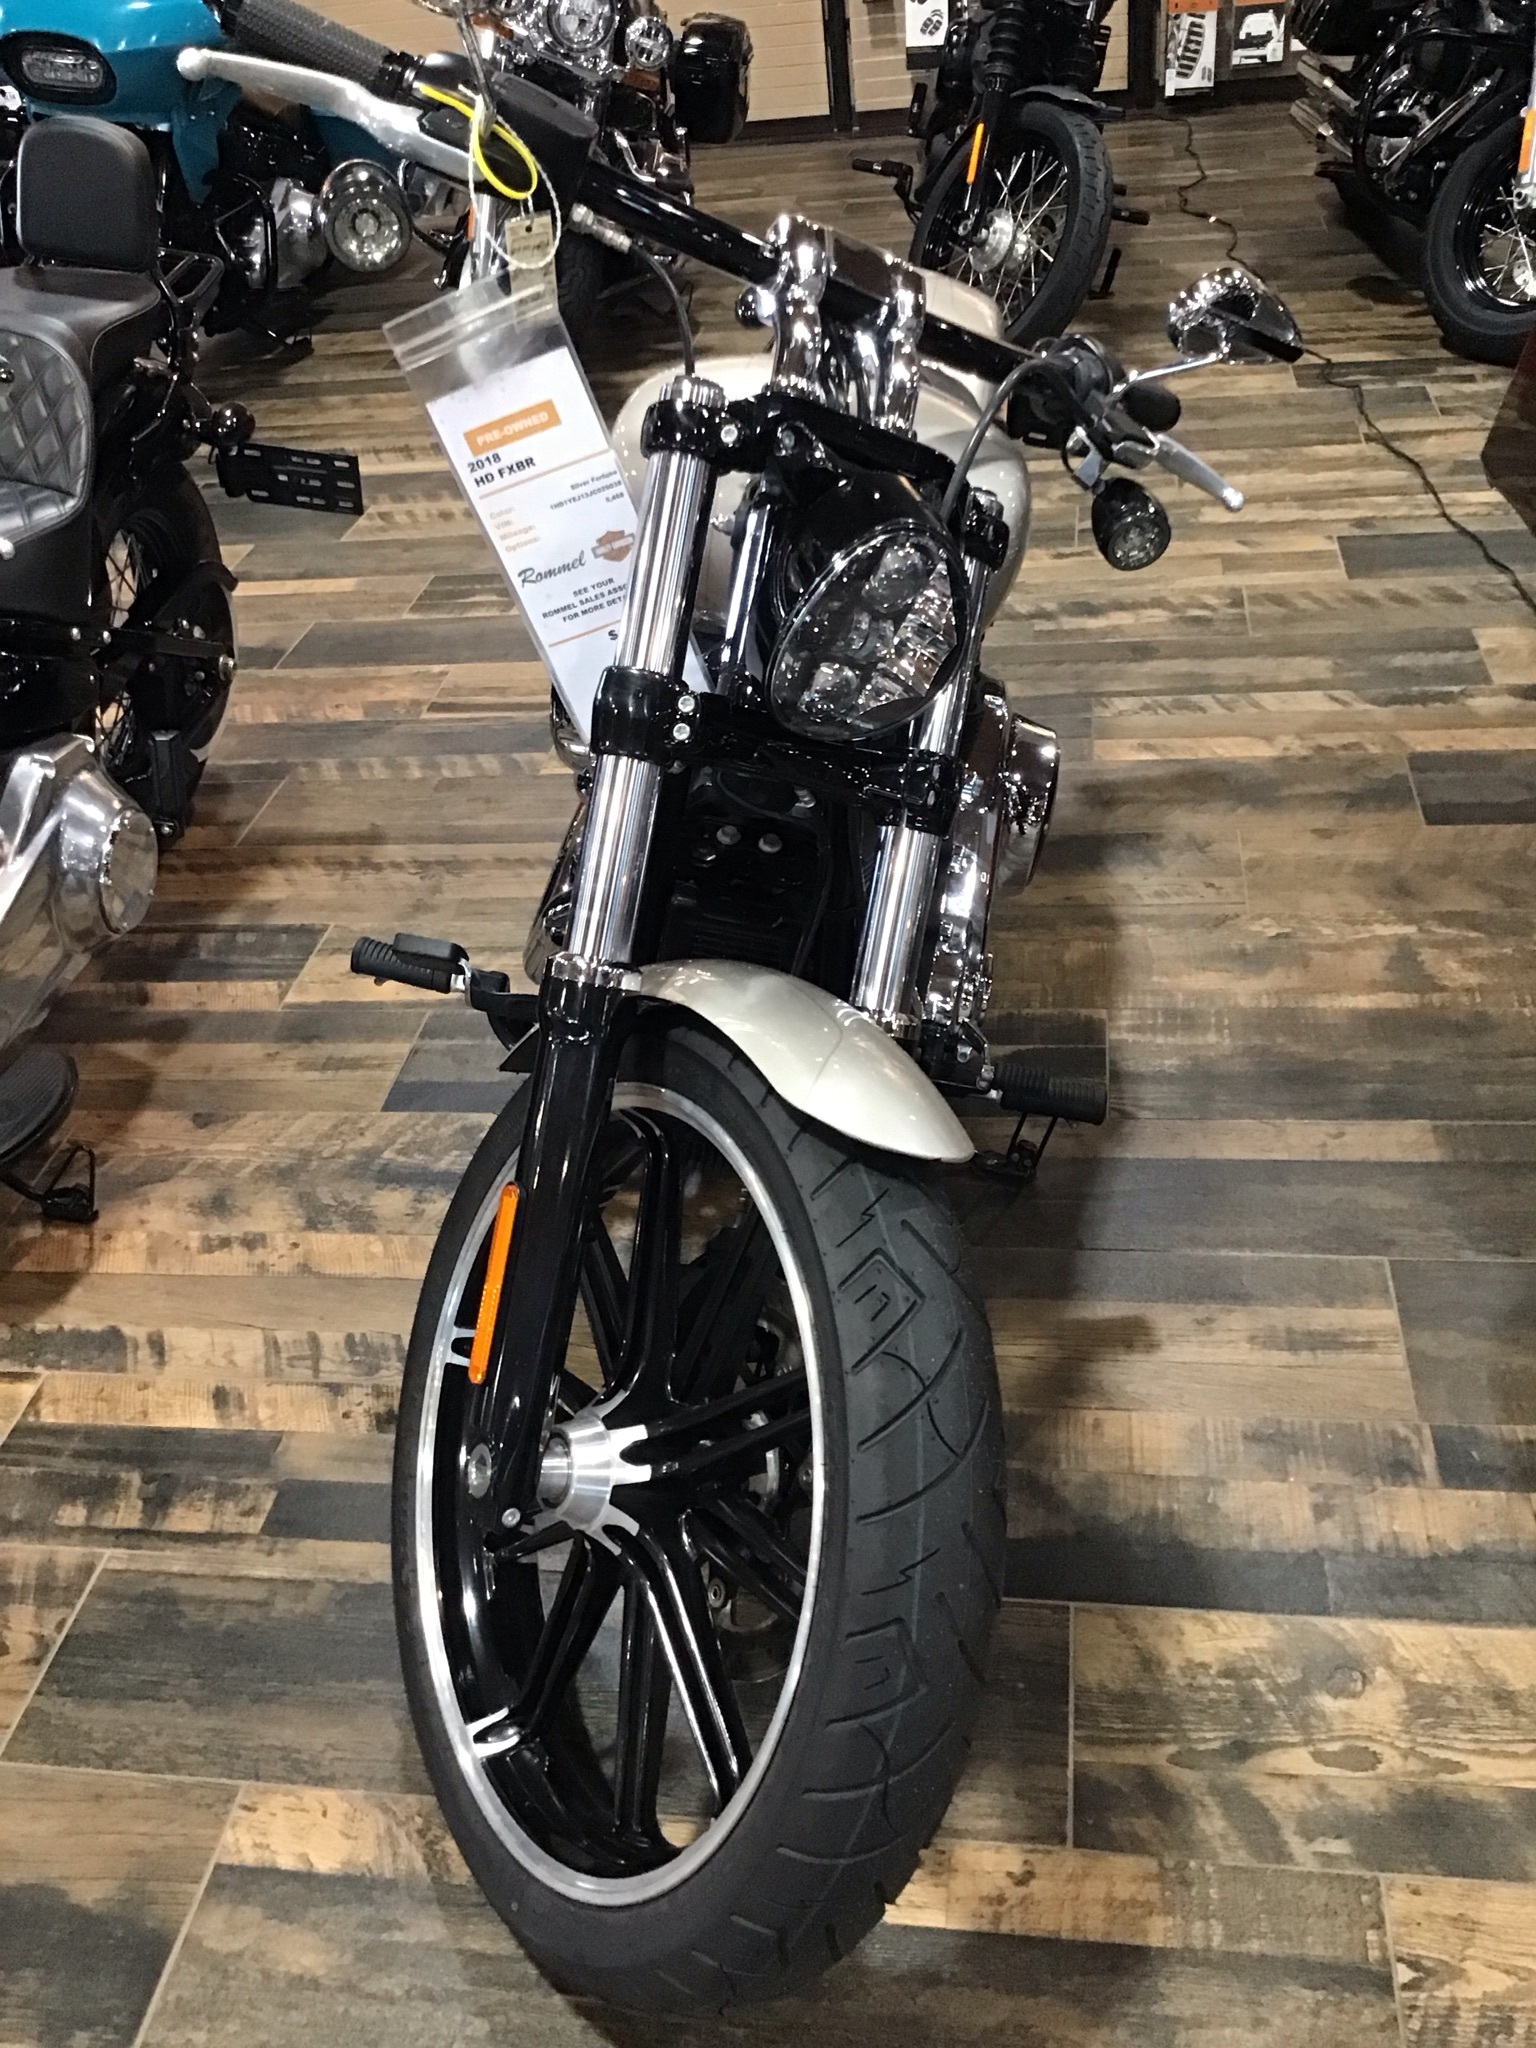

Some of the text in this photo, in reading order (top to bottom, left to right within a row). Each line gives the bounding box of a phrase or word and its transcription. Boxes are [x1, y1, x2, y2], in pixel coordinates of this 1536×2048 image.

[476, 411, 549, 447] PRE-OWNED
[467, 452, 502, 473] 2018
[473, 456, 536, 488] HD FXBR
[517, 549, 586, 588] Rommel
[572, 577, 615, 598] SEE YOUR
[542, 602, 578, 619] ROMMEL
[578, 591, 606, 606] SALES
[562, 612, 580, 623] FOR
[581, 603, 606, 617] MORE
